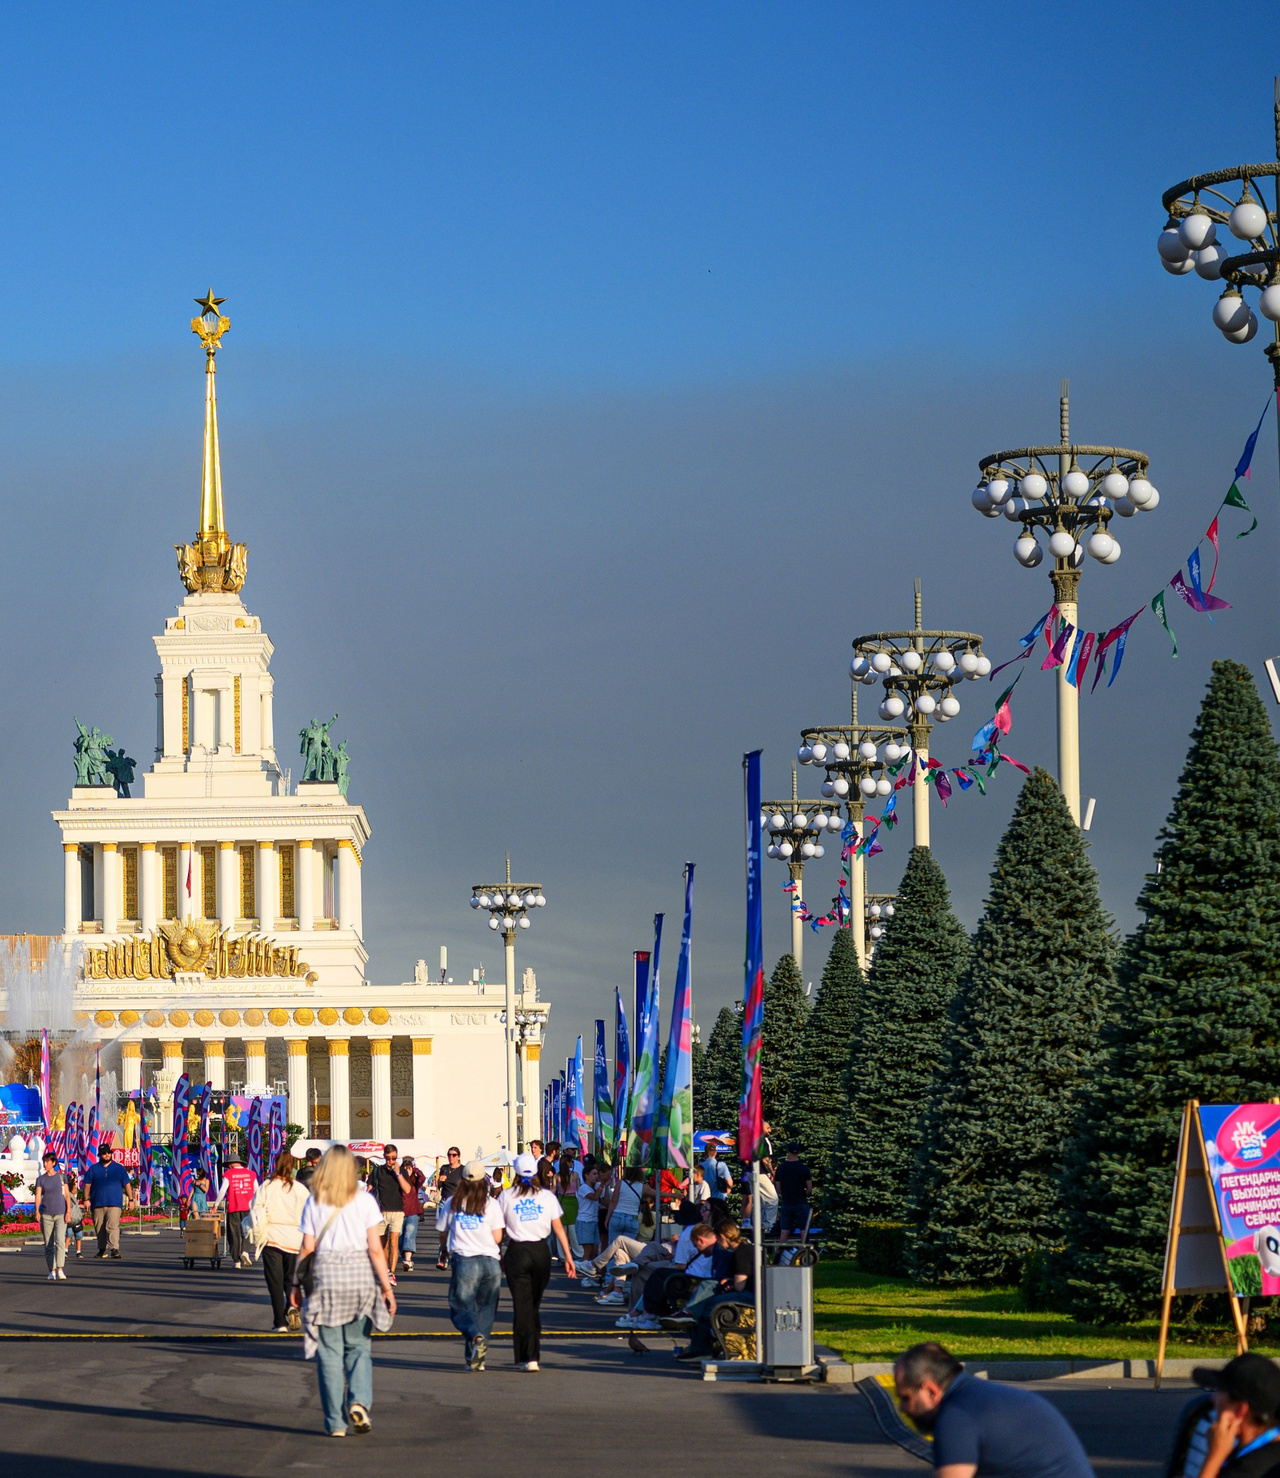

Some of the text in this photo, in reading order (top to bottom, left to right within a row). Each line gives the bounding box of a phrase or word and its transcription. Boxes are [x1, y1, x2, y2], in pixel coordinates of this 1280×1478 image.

[1236, 1121, 1255, 1135] VK
[1231, 1130, 1267, 1149] fest
[519, 1198, 536, 1206] VK
[513, 1204, 544, 1215] fest
